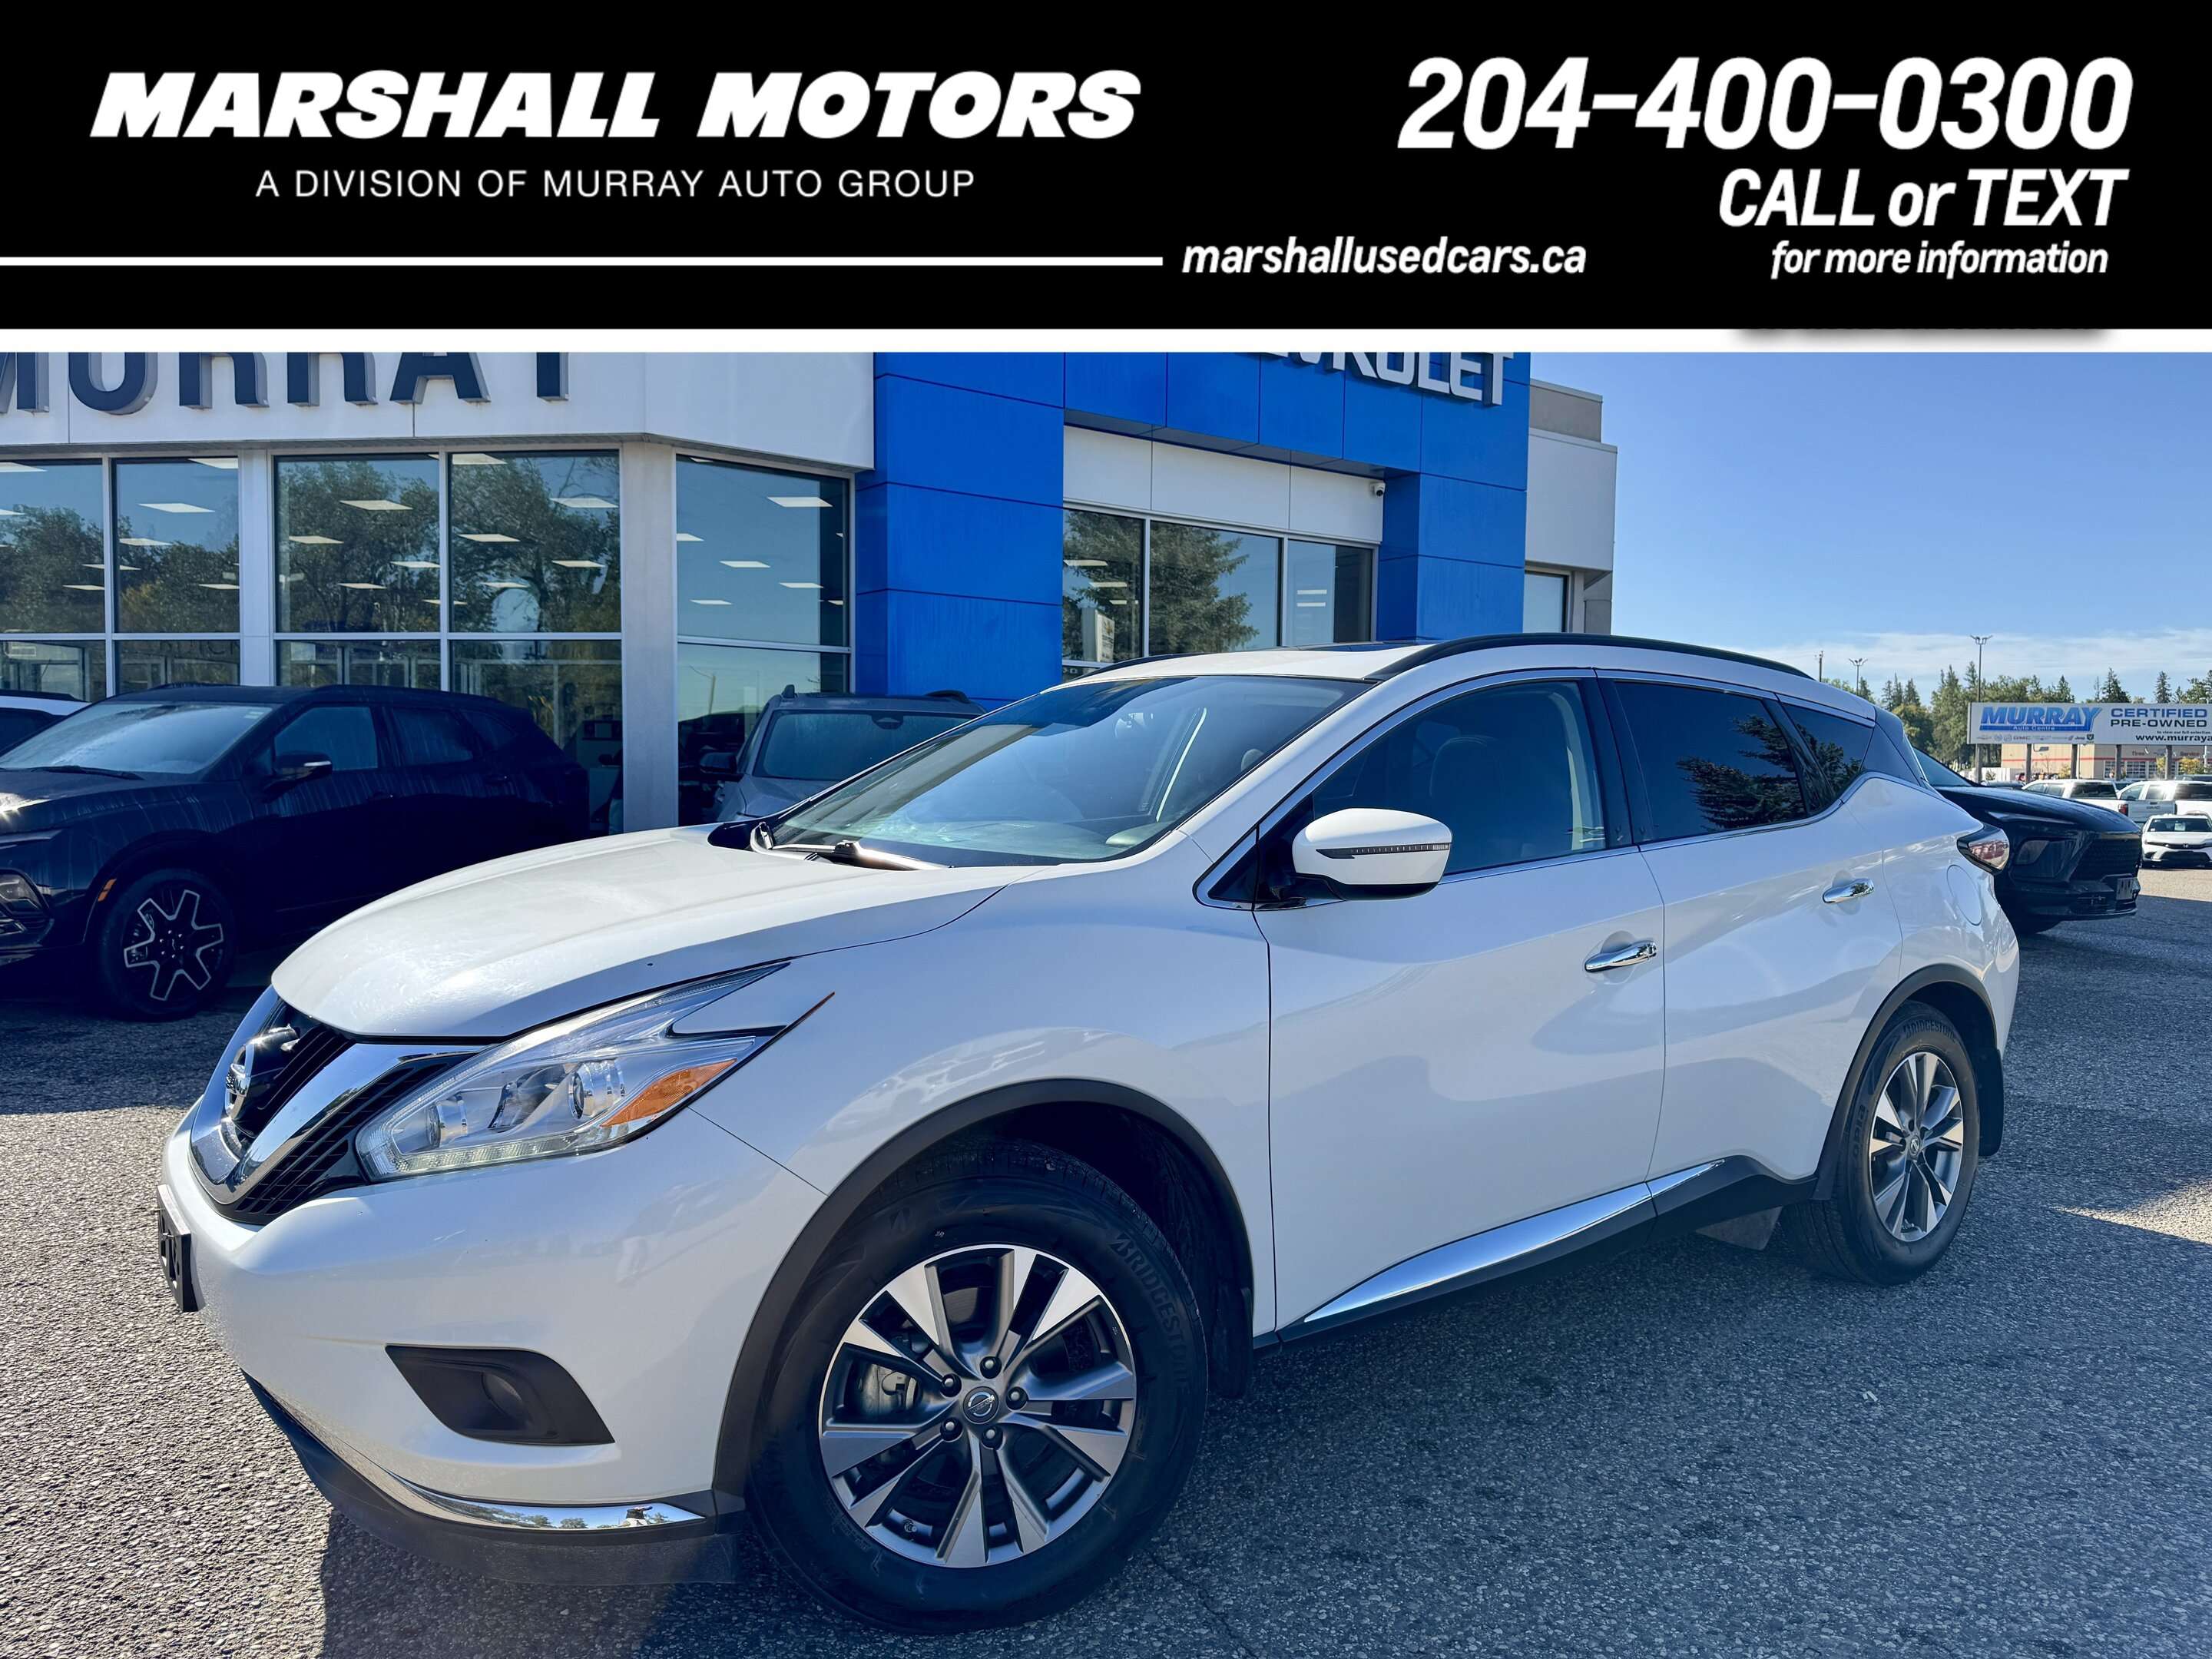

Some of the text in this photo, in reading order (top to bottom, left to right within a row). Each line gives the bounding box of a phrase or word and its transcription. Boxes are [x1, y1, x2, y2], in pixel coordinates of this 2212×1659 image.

[1980, 707, 2102, 726] MURRAY
[2111, 708, 2207, 718] CERTIFIED
[2110, 719, 2207, 727] PRE-OWNED
